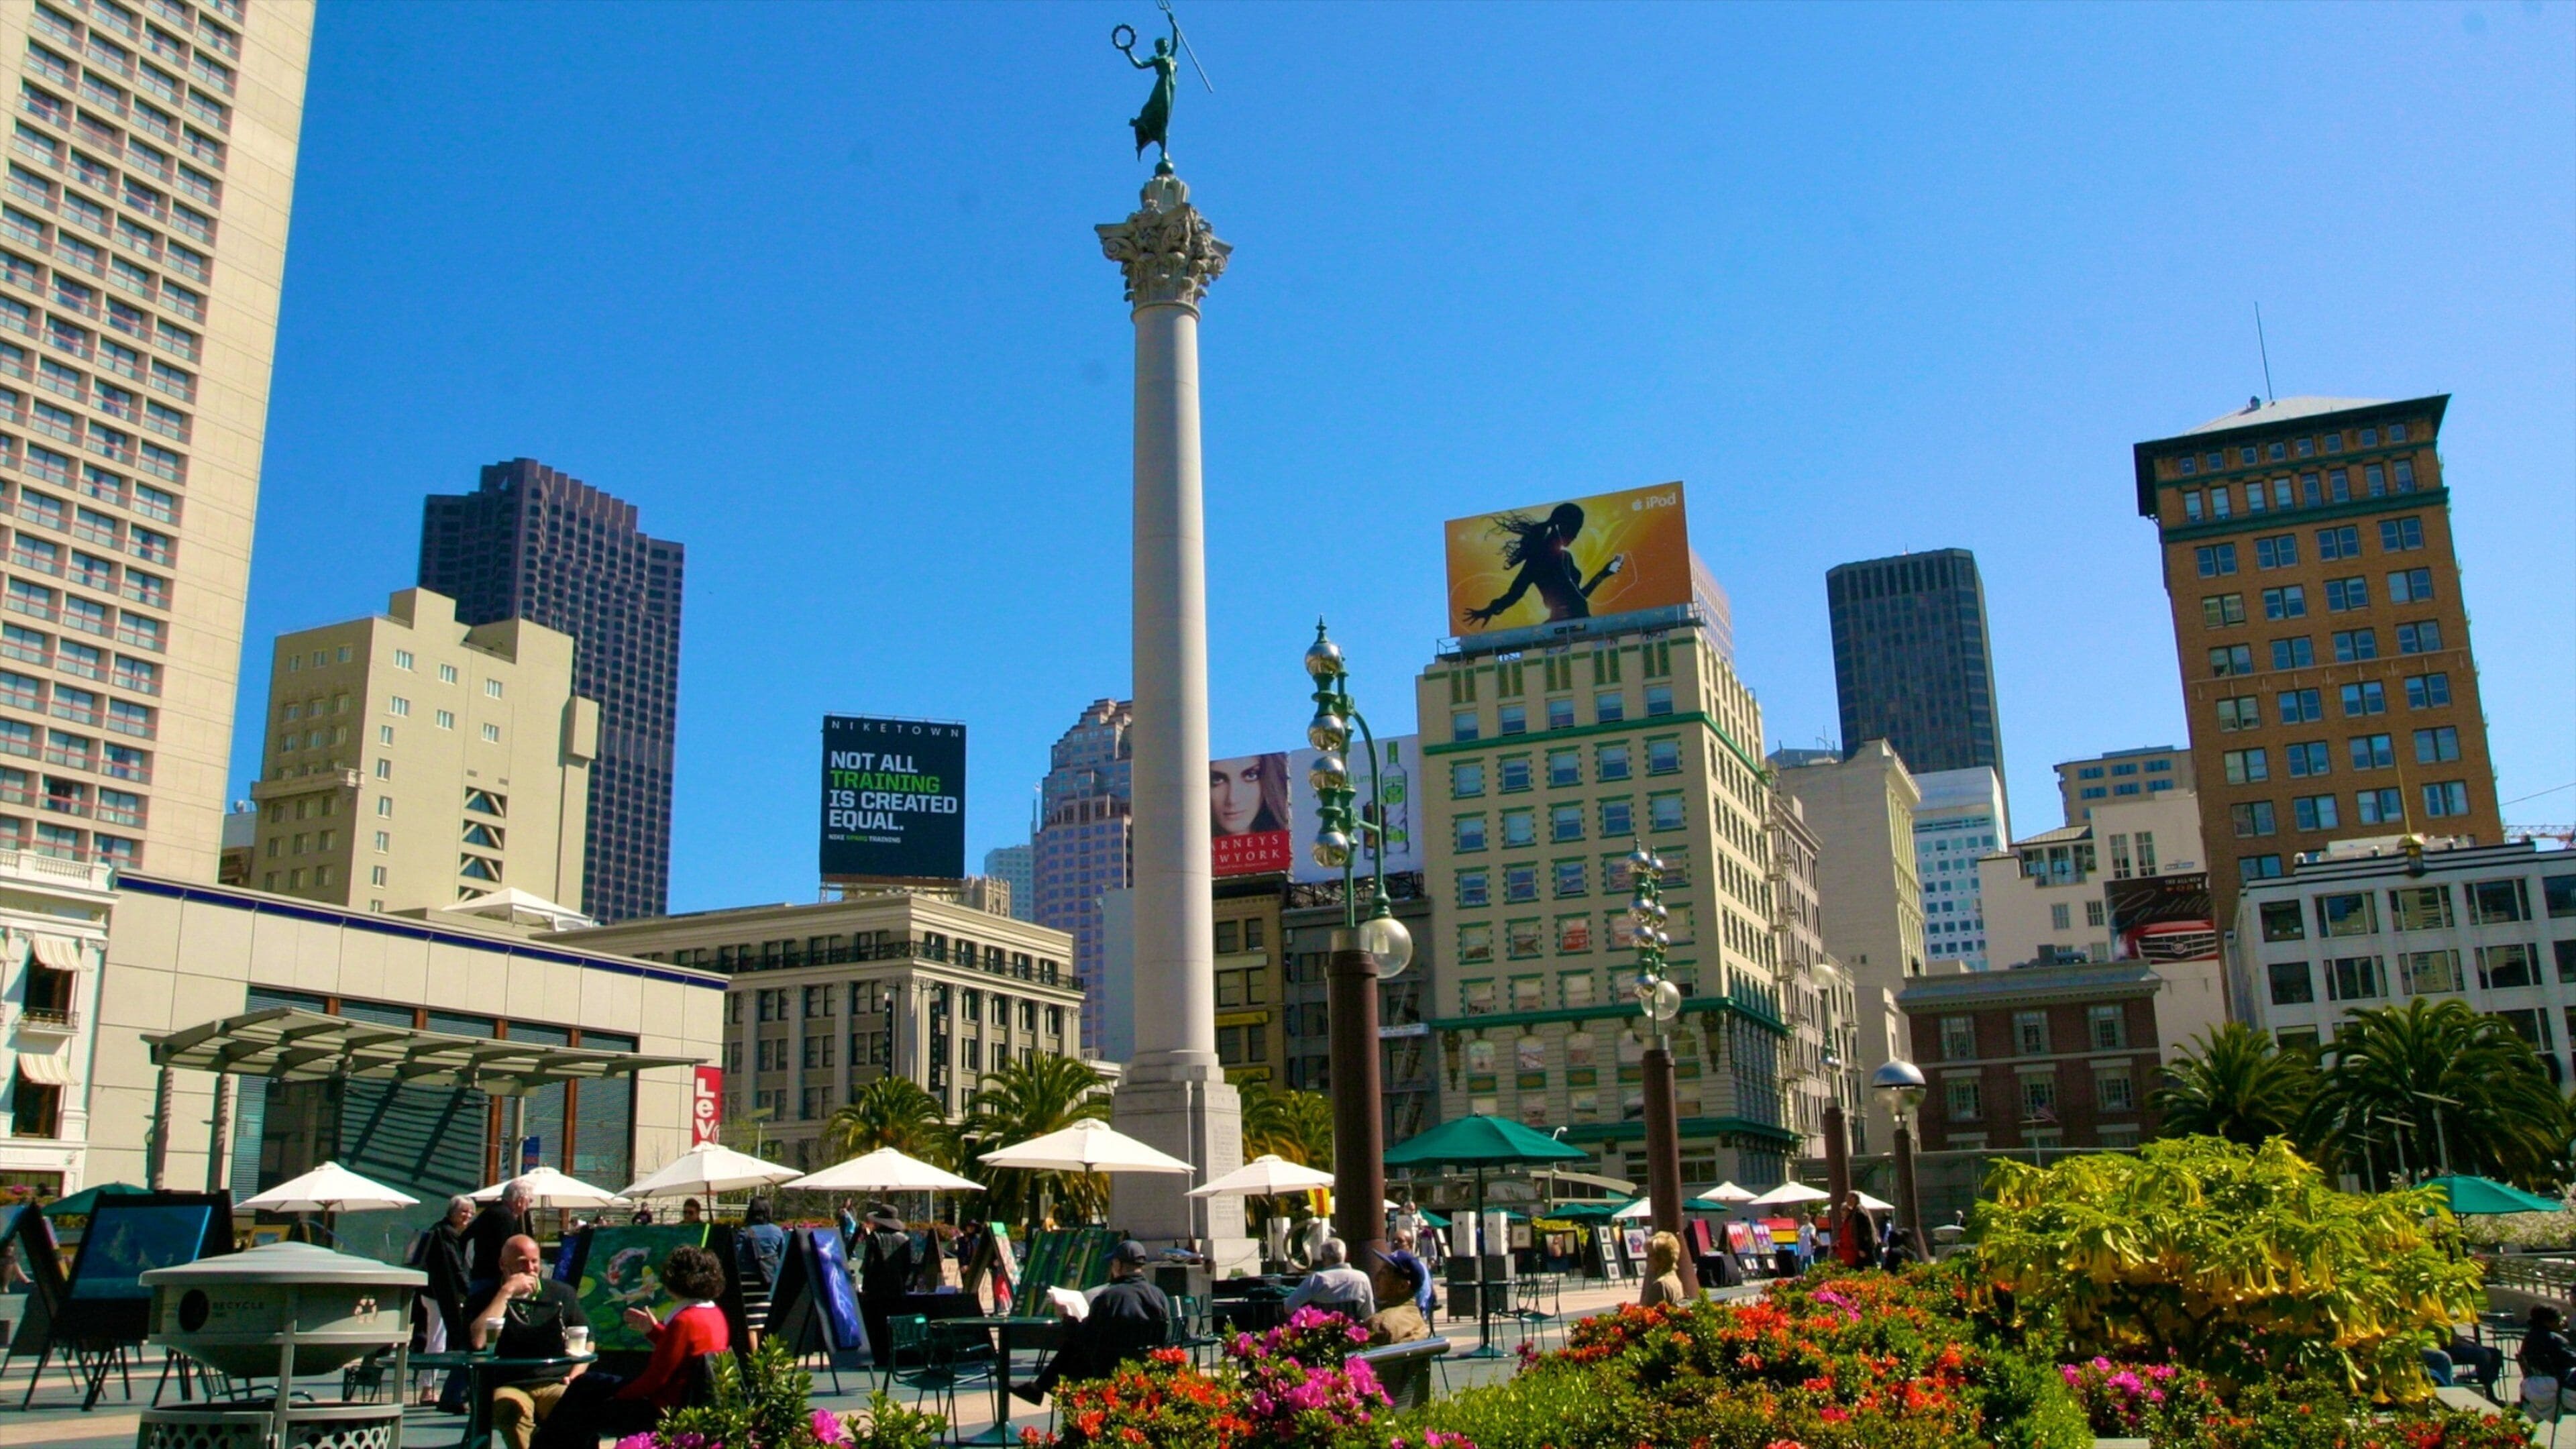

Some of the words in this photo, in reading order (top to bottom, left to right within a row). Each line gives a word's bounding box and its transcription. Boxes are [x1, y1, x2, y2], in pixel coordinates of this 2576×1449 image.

[1646, 492, 1676, 509] iPod
[831, 720, 959, 738] NIKETOWN
[830, 750, 875, 771] NOT
[879, 753, 918, 773] ALL
[830, 770, 941, 794] TRAINING
[828, 790, 855, 808] IS
[861, 791, 957, 814] CREATED
[828, 809, 904, 831] EQUAL.
[212, 1301, 265, 1309] RECYCLE
